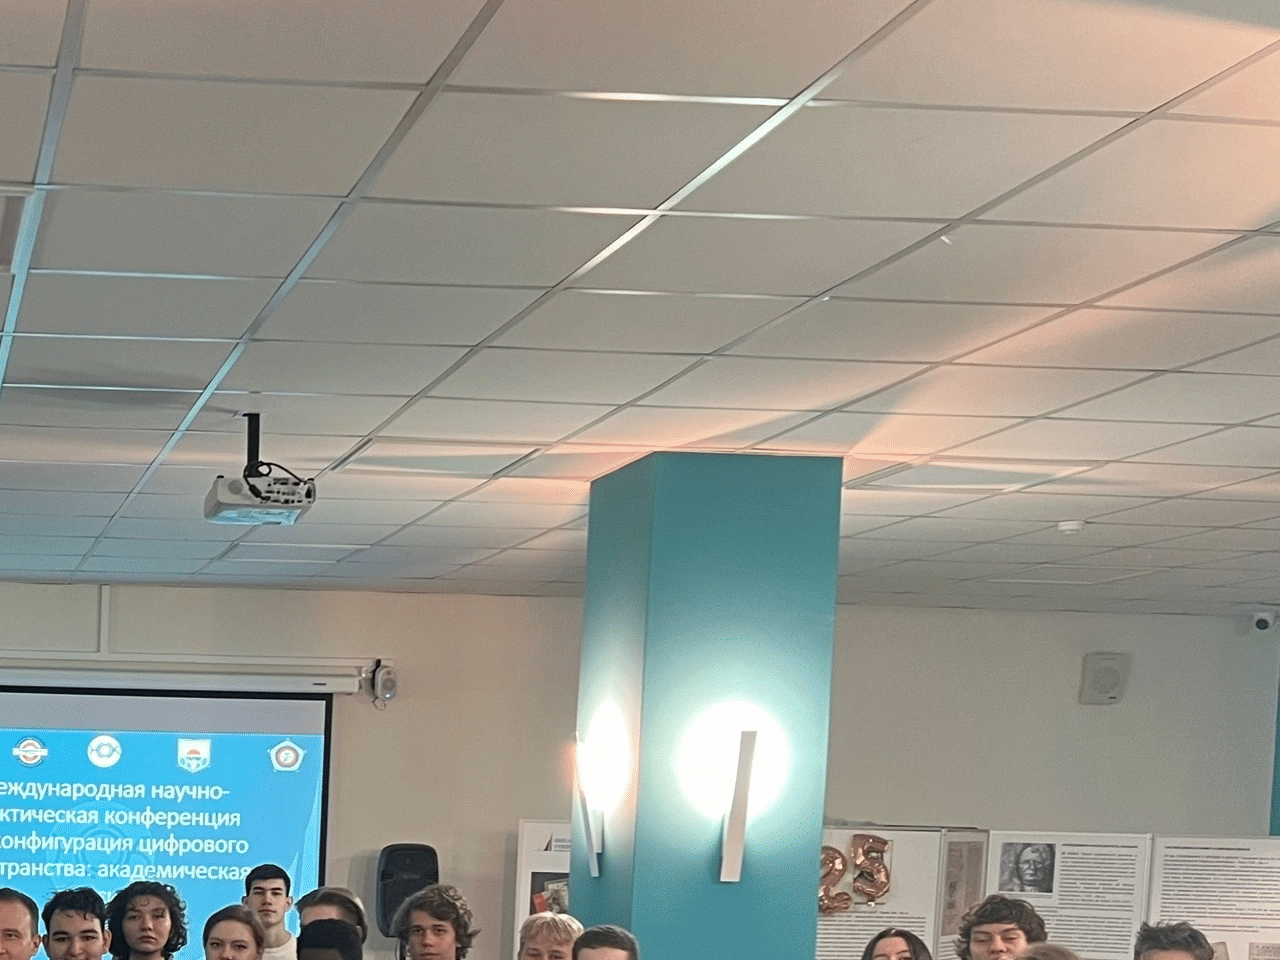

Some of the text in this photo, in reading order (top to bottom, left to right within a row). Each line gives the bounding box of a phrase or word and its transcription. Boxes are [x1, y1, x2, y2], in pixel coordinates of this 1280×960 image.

[151, 784, 230, 803] научно-
[105, 806, 241, 830] конференция
[139, 833, 249, 856] цифрового
[97, 863, 252, 882] академическая
